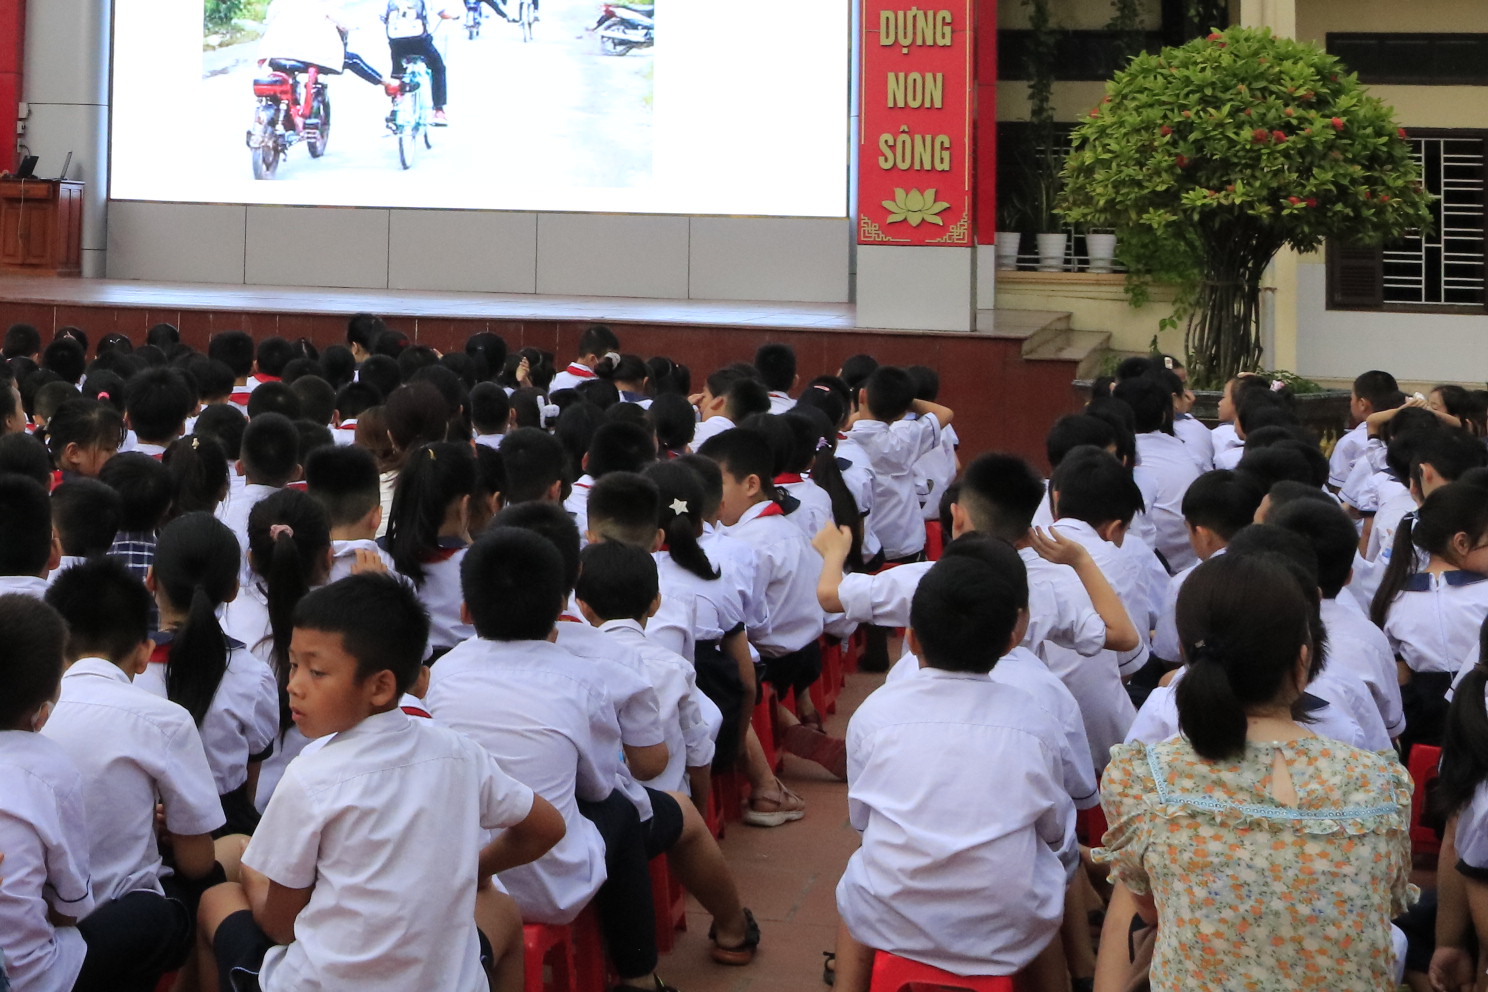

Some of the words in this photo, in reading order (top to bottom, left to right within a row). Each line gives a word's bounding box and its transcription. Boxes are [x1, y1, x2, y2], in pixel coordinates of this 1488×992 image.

[879, 6, 953, 54] DỰNG
[887, 72, 944, 109] NON
[878, 125, 952, 172] SÔNG
